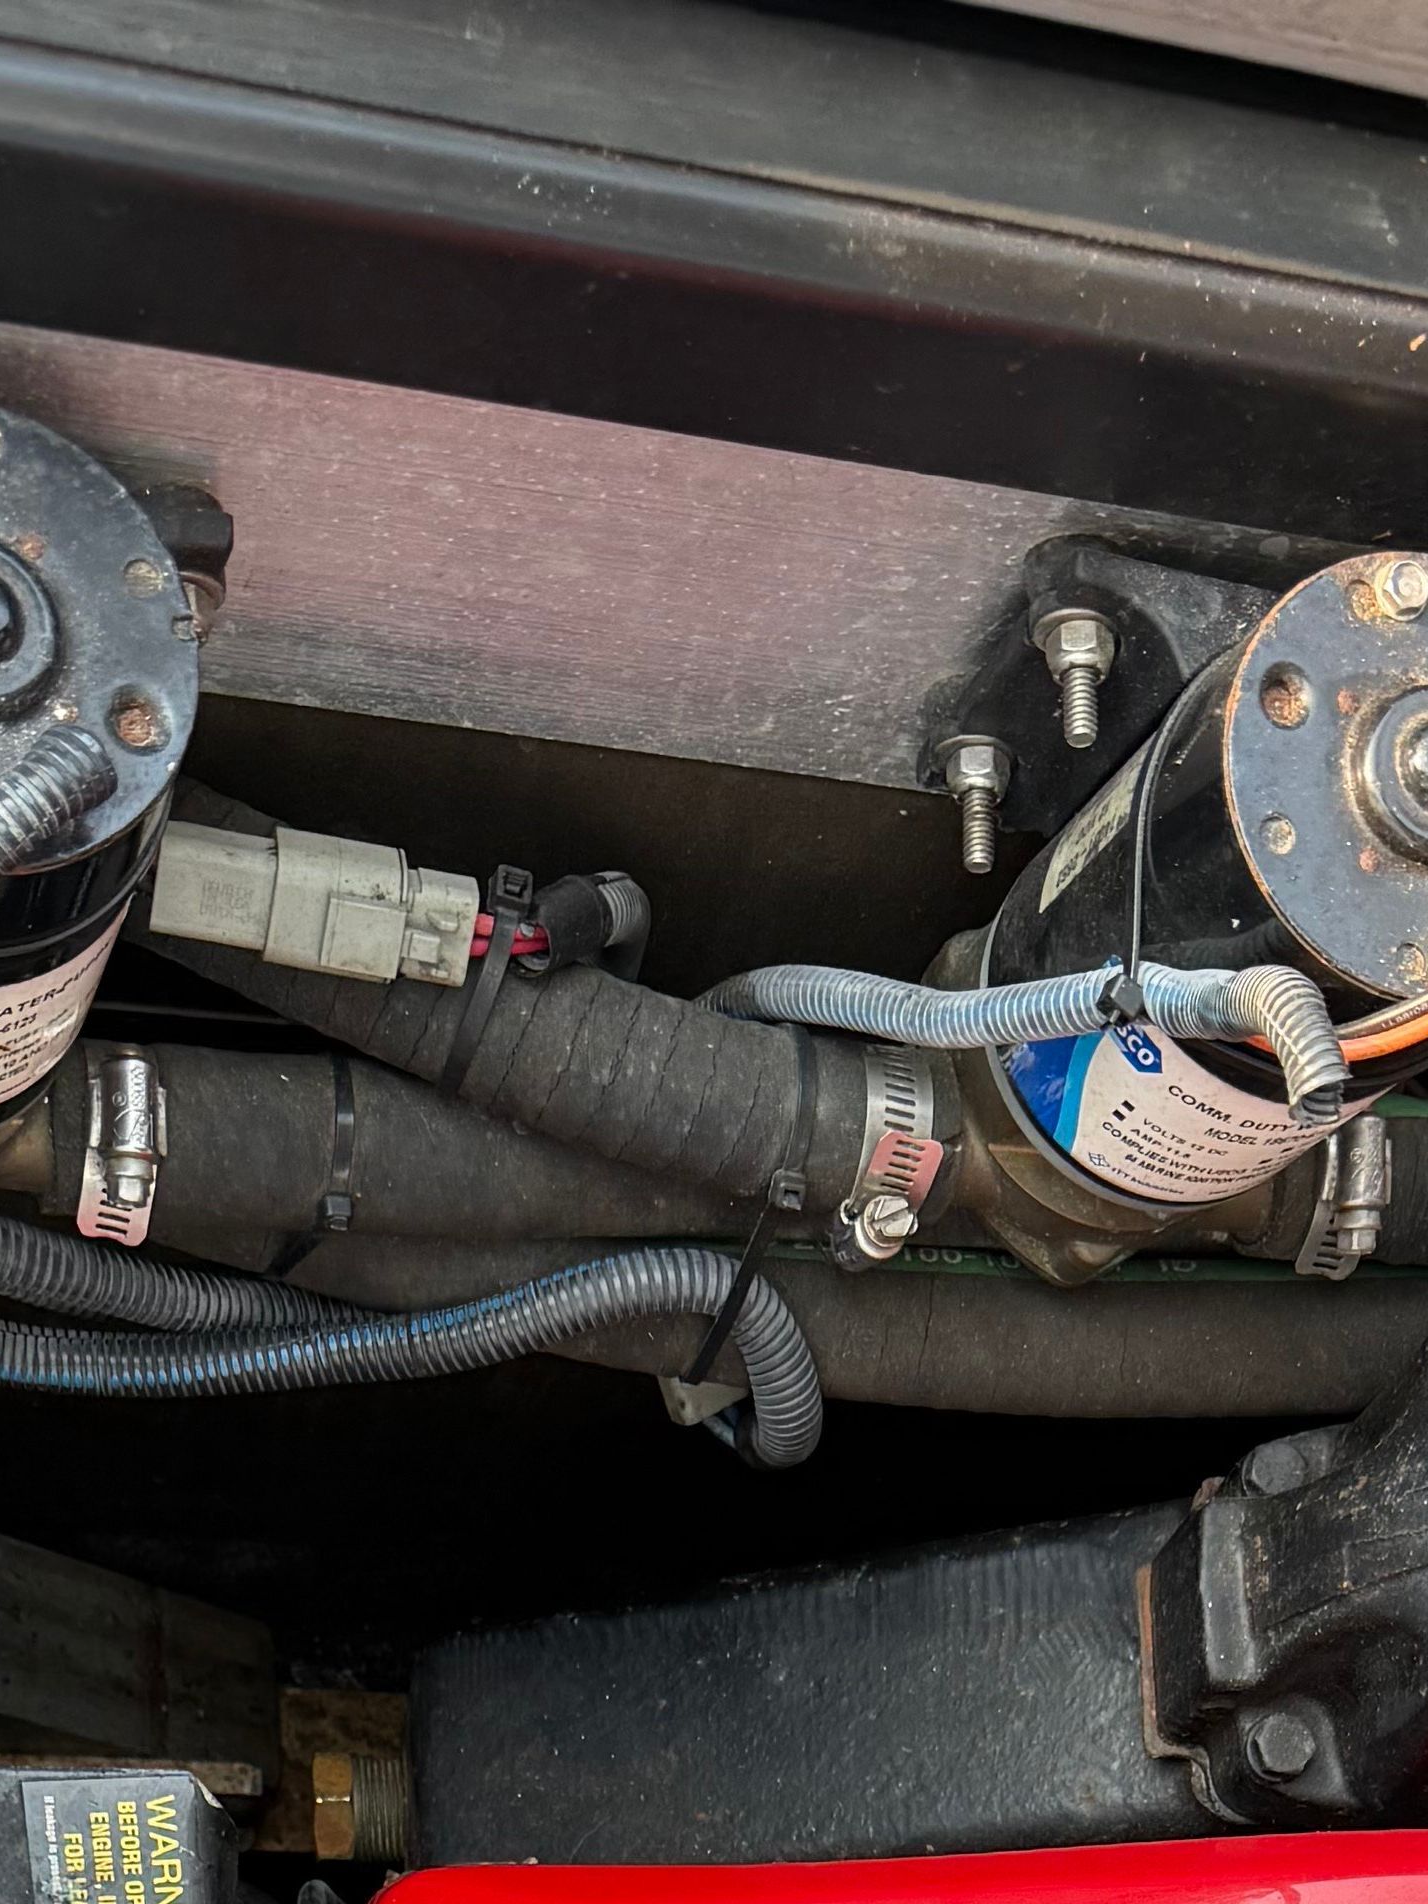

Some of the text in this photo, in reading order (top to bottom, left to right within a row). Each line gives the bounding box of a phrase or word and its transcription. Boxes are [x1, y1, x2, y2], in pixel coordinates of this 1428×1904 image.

[1116, 1024, 1157, 1067] SCO
[1168, 1084, 1232, 1125] COMM.
[63, 1832, 86, 1873] FOR
[89, 1812, 115, 1889] ENGINE,
[117, 1800, 142, 1875] BEFORE
